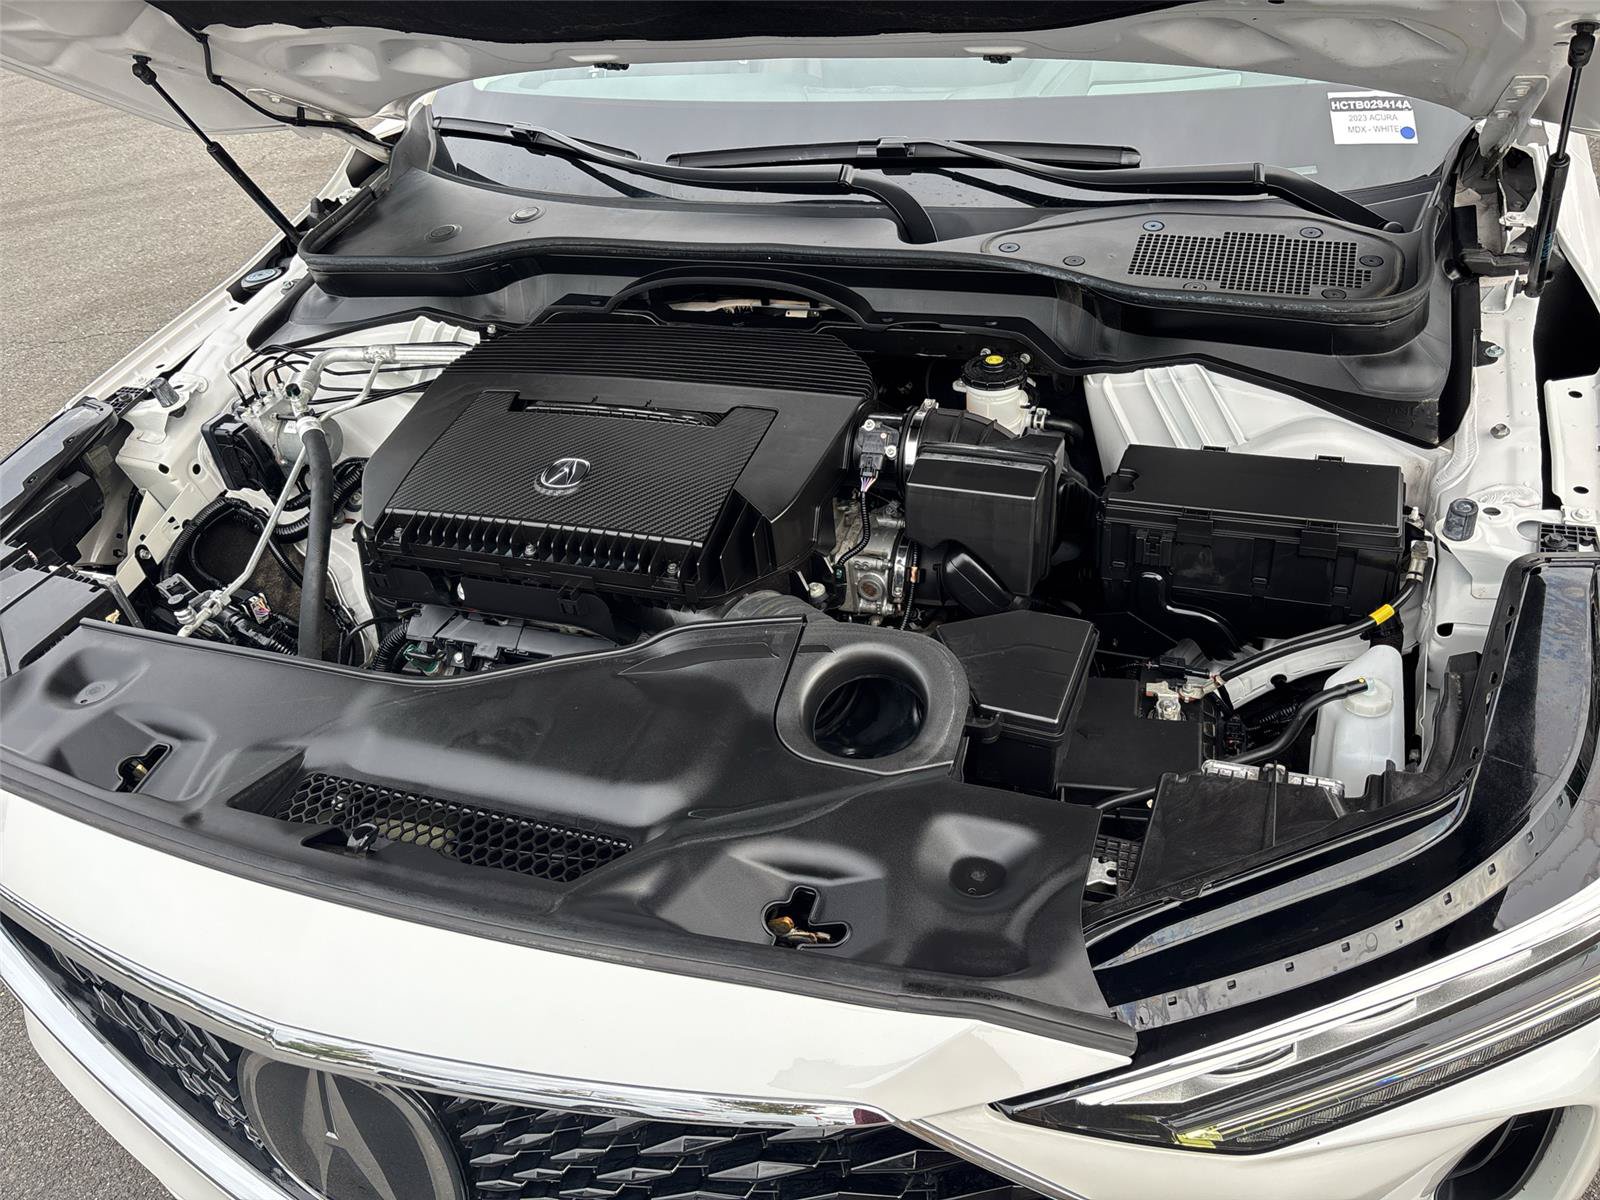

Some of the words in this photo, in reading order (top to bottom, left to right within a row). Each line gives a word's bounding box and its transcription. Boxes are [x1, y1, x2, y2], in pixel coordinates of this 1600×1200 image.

[1331, 99, 1412, 110] HCTB029414A
[1348, 114, 1367, 122] 2023
[1369, 113, 1398, 121] ACURA
[1347, 126, 1367, 134] MDX
[1372, 125, 1400, 133] WHITE
